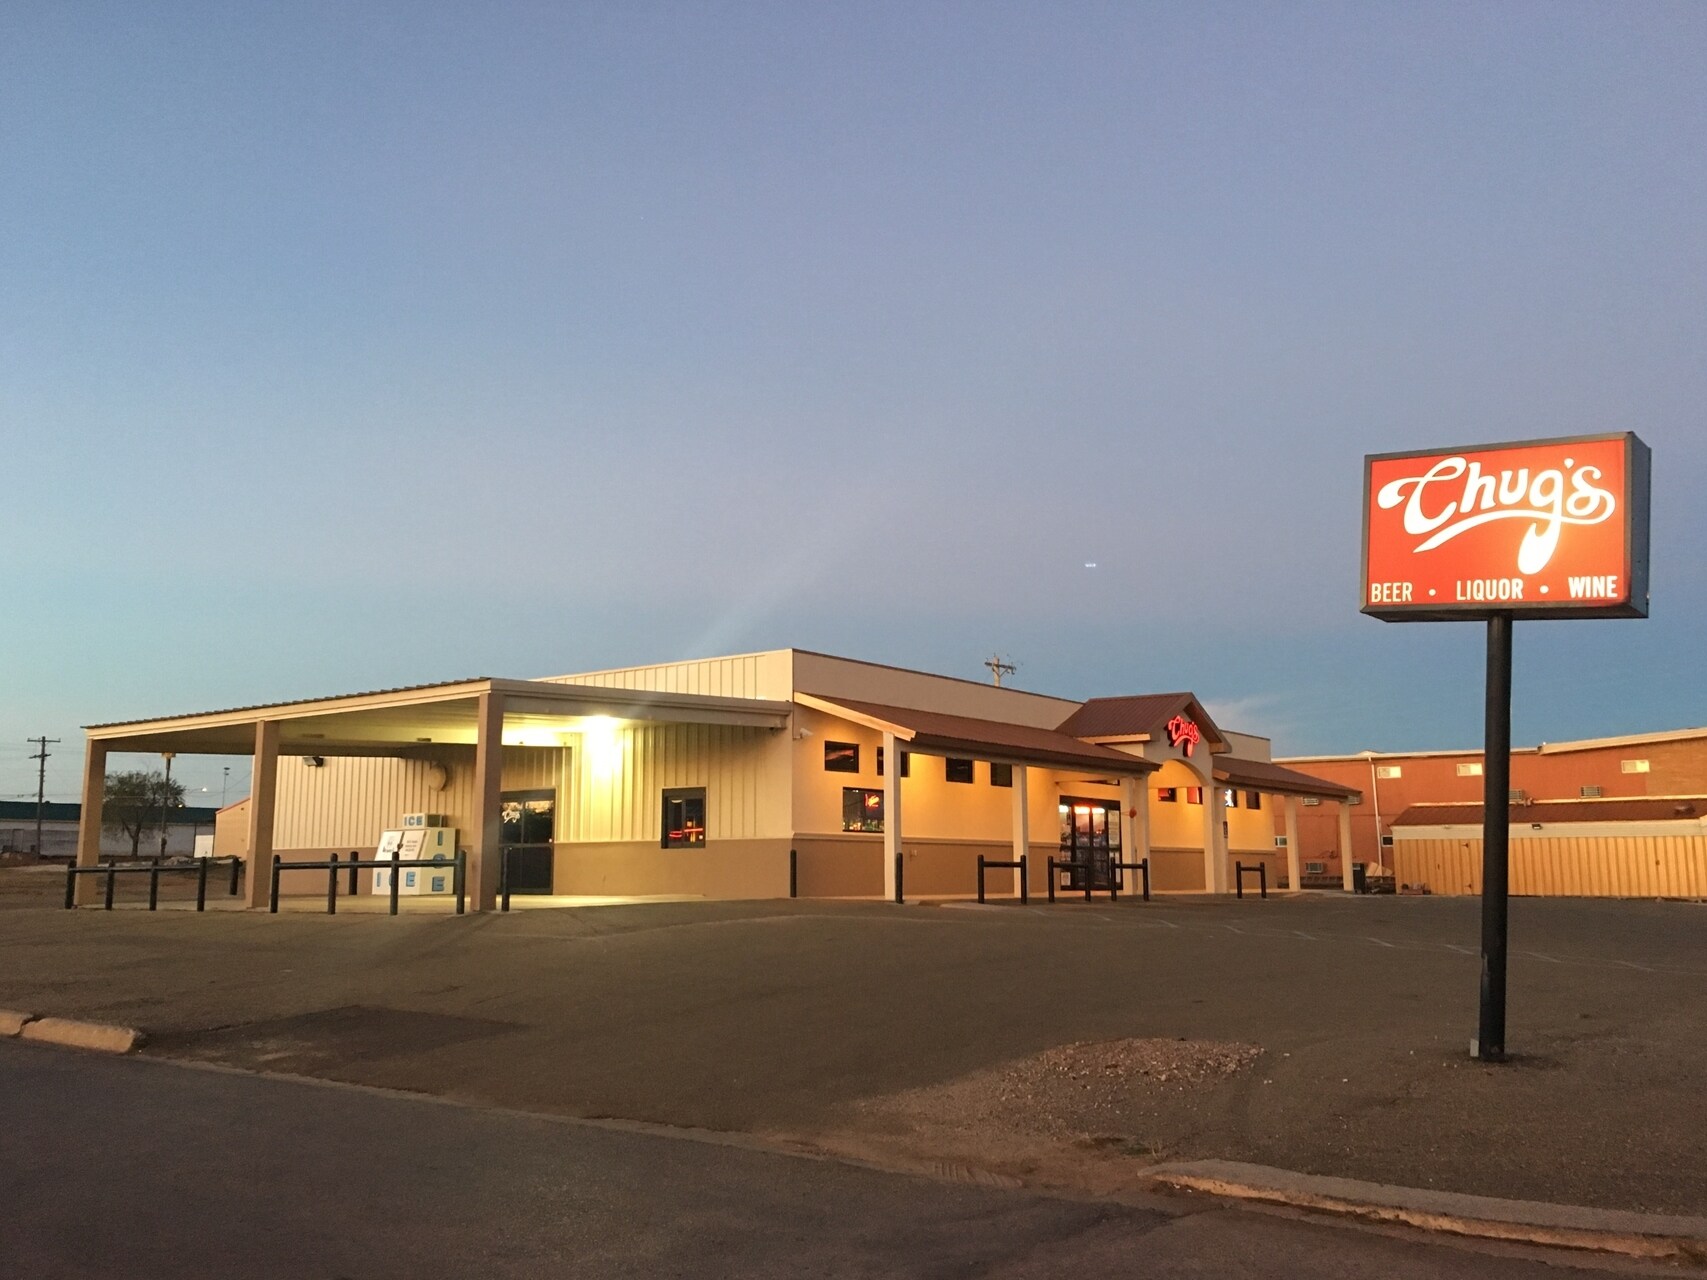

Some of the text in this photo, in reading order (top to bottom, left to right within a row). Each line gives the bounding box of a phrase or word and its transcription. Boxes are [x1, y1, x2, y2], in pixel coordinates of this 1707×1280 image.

[1377, 456, 1616, 575] Chug's
[1371, 576, 1618, 602] BEER LIQUOR WINE
[1168, 715, 1200, 758] Chug's
[404, 816, 423, 826] ICE
[376, 871, 416, 887] IE
